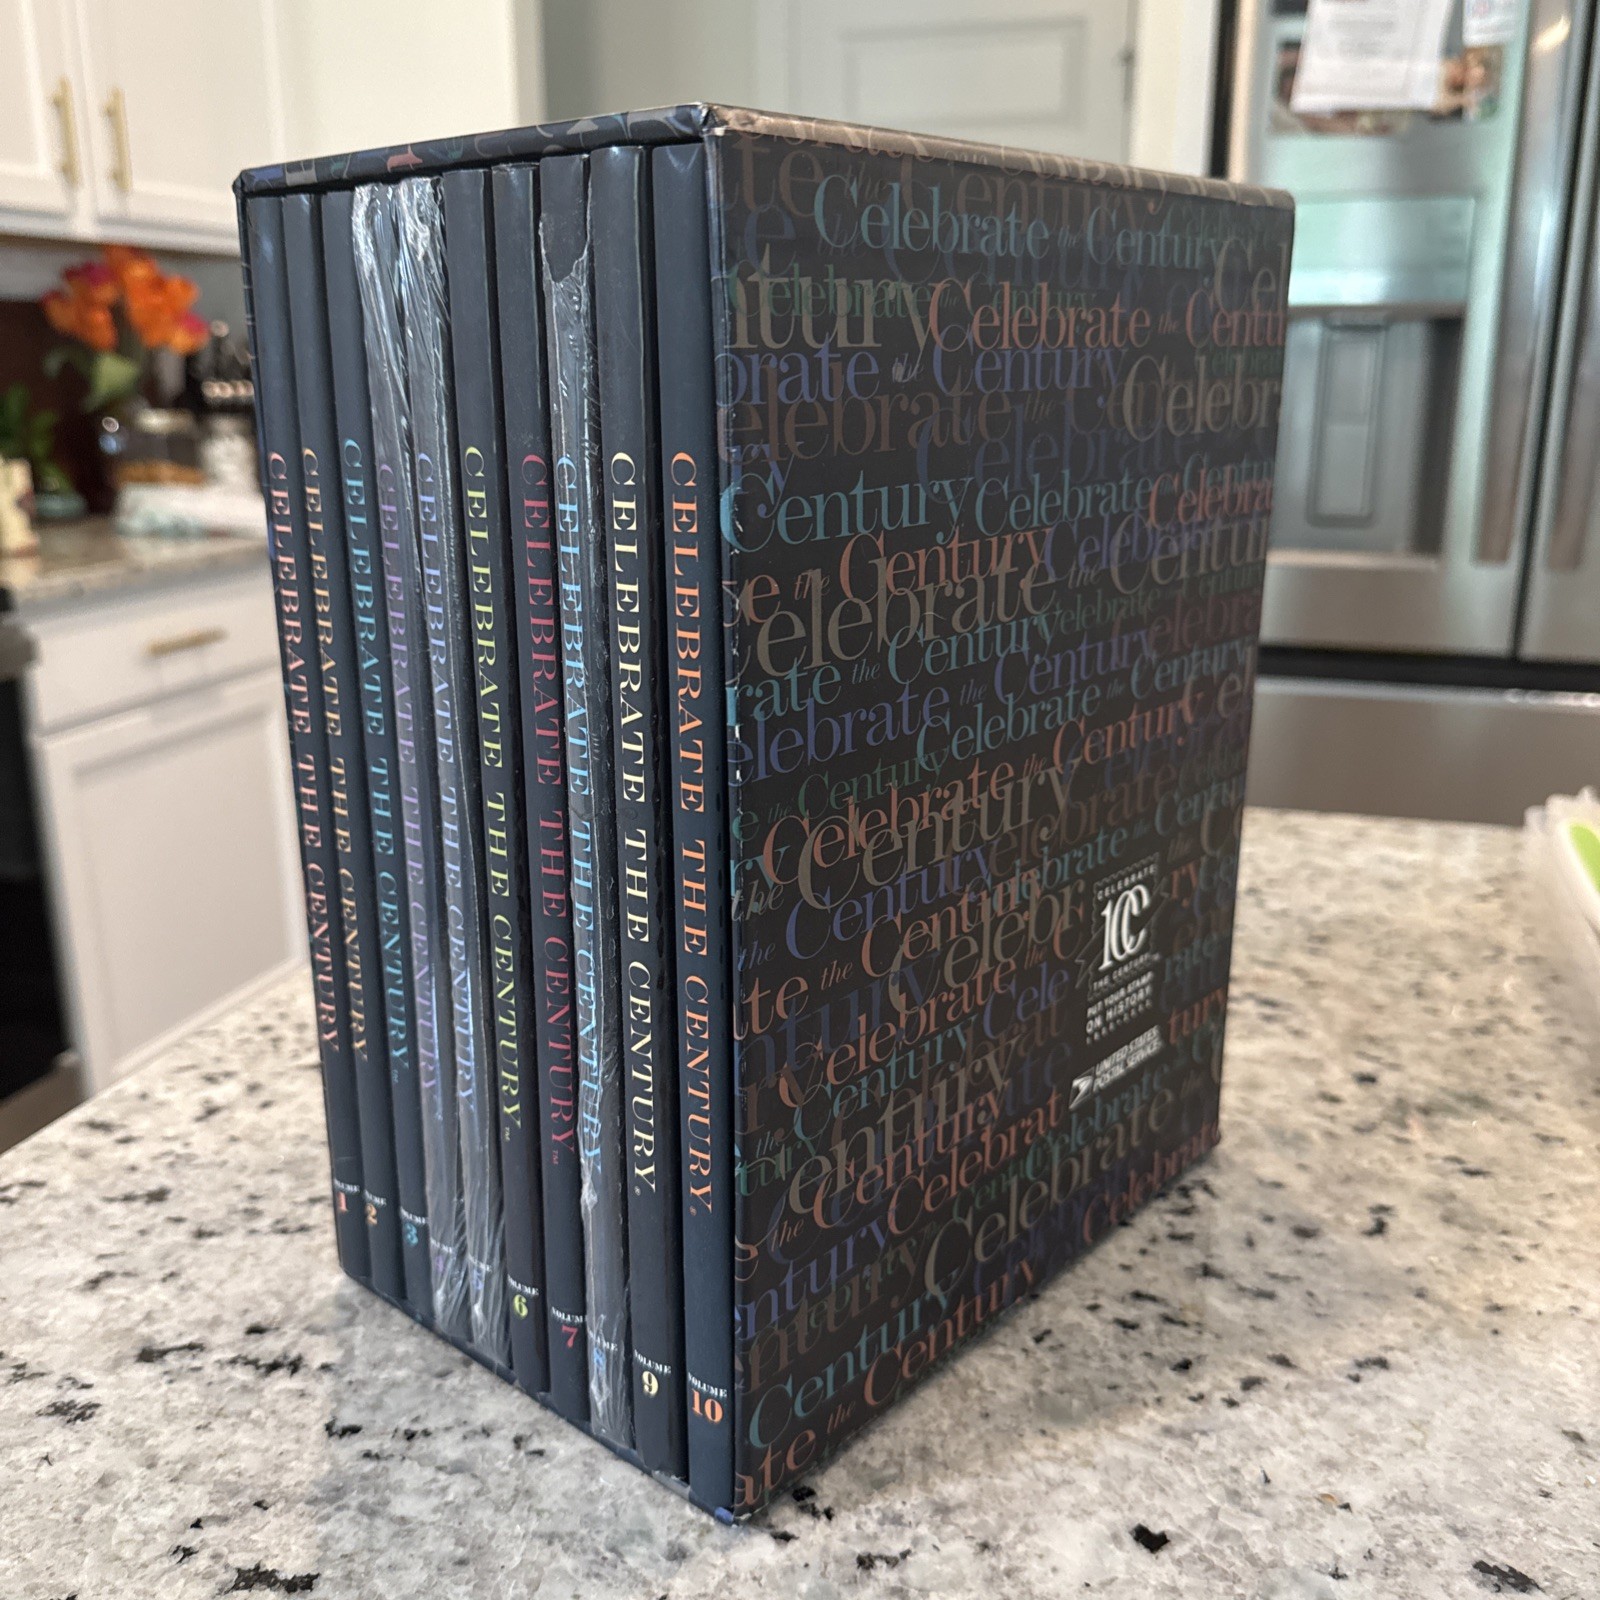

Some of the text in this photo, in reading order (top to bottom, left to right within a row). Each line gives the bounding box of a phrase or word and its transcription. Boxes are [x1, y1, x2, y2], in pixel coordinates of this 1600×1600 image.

[814, 173, 1050, 261] Celebrate
[1086, 205, 1226, 288] Century
[929, 277, 1151, 353] Celebrate
[932, 324, 1128, 410] Century
[1122, 353, 1280, 443] Celebr
[719, 470, 976, 553] Century
[975, 467, 1154, 537] Celebrate
[838, 525, 1055, 605] Century
[465, 446, 503, 768] CELEBRATE
[522, 454, 562, 785] CELEBRATE
[726, 613, 1056, 724] rate the Century
[994, 627, 1158, 706] Century
[379, 463, 416, 764] CELEBRATE
[403, 786, 424, 885] THE
[916, 680, 1101, 772] Celebrate
[1130, 637, 1254, 700] Century
[268, 451, 340, 1053] CELEBRATE THE CENTURY
[302, 447, 368, 1063] CELEBRATE THE CENTURY
[344, 438, 409, 1071] CELEBRATE THE CENTURY
[418, 452, 476, 1112] CELEBRATE THE CENTURY
[486, 791, 510, 897] THE
[539, 810, 567, 918] THE
[556, 456, 602, 1174] CELEBRATE THE CENTURY
[611, 451, 656, 1194] CELEBRATE THE CENTURY
[670, 451, 713, 1214] CELEBRATE THE CENTURY
[763, 757, 1015, 885] Celebrate
[797, 755, 1084, 911] Century
[785, 838, 998, 961] Century
[493, 914, 522, 1129] CENTURY
[779, 957, 1018, 1109] Celebrate
[820, 959, 854, 991] the
[1085, 1014, 1103, 1035] ON
[544, 936, 575, 1153] CENTURY
[793, 1013, 979, 1143] Century
[813, 1083, 1006, 1229] Century
[924, 1087, 1175, 1298] Celebrate
[404, 1222, 419, 1246] 3
[513, 1293, 529, 1319] 6
[551, 1306, 587, 1324] VOLUM
[561, 1325, 579, 1349] 7
[634, 1348, 672, 1375] VOLUME
[749, 1262, 960, 1449] Century
[863, 1257, 1036, 1407] Century
[641, 1370, 659, 1397] 9
[687, 1371, 728, 1398] VOLUME
[691, 1388, 724, 1424] 10
